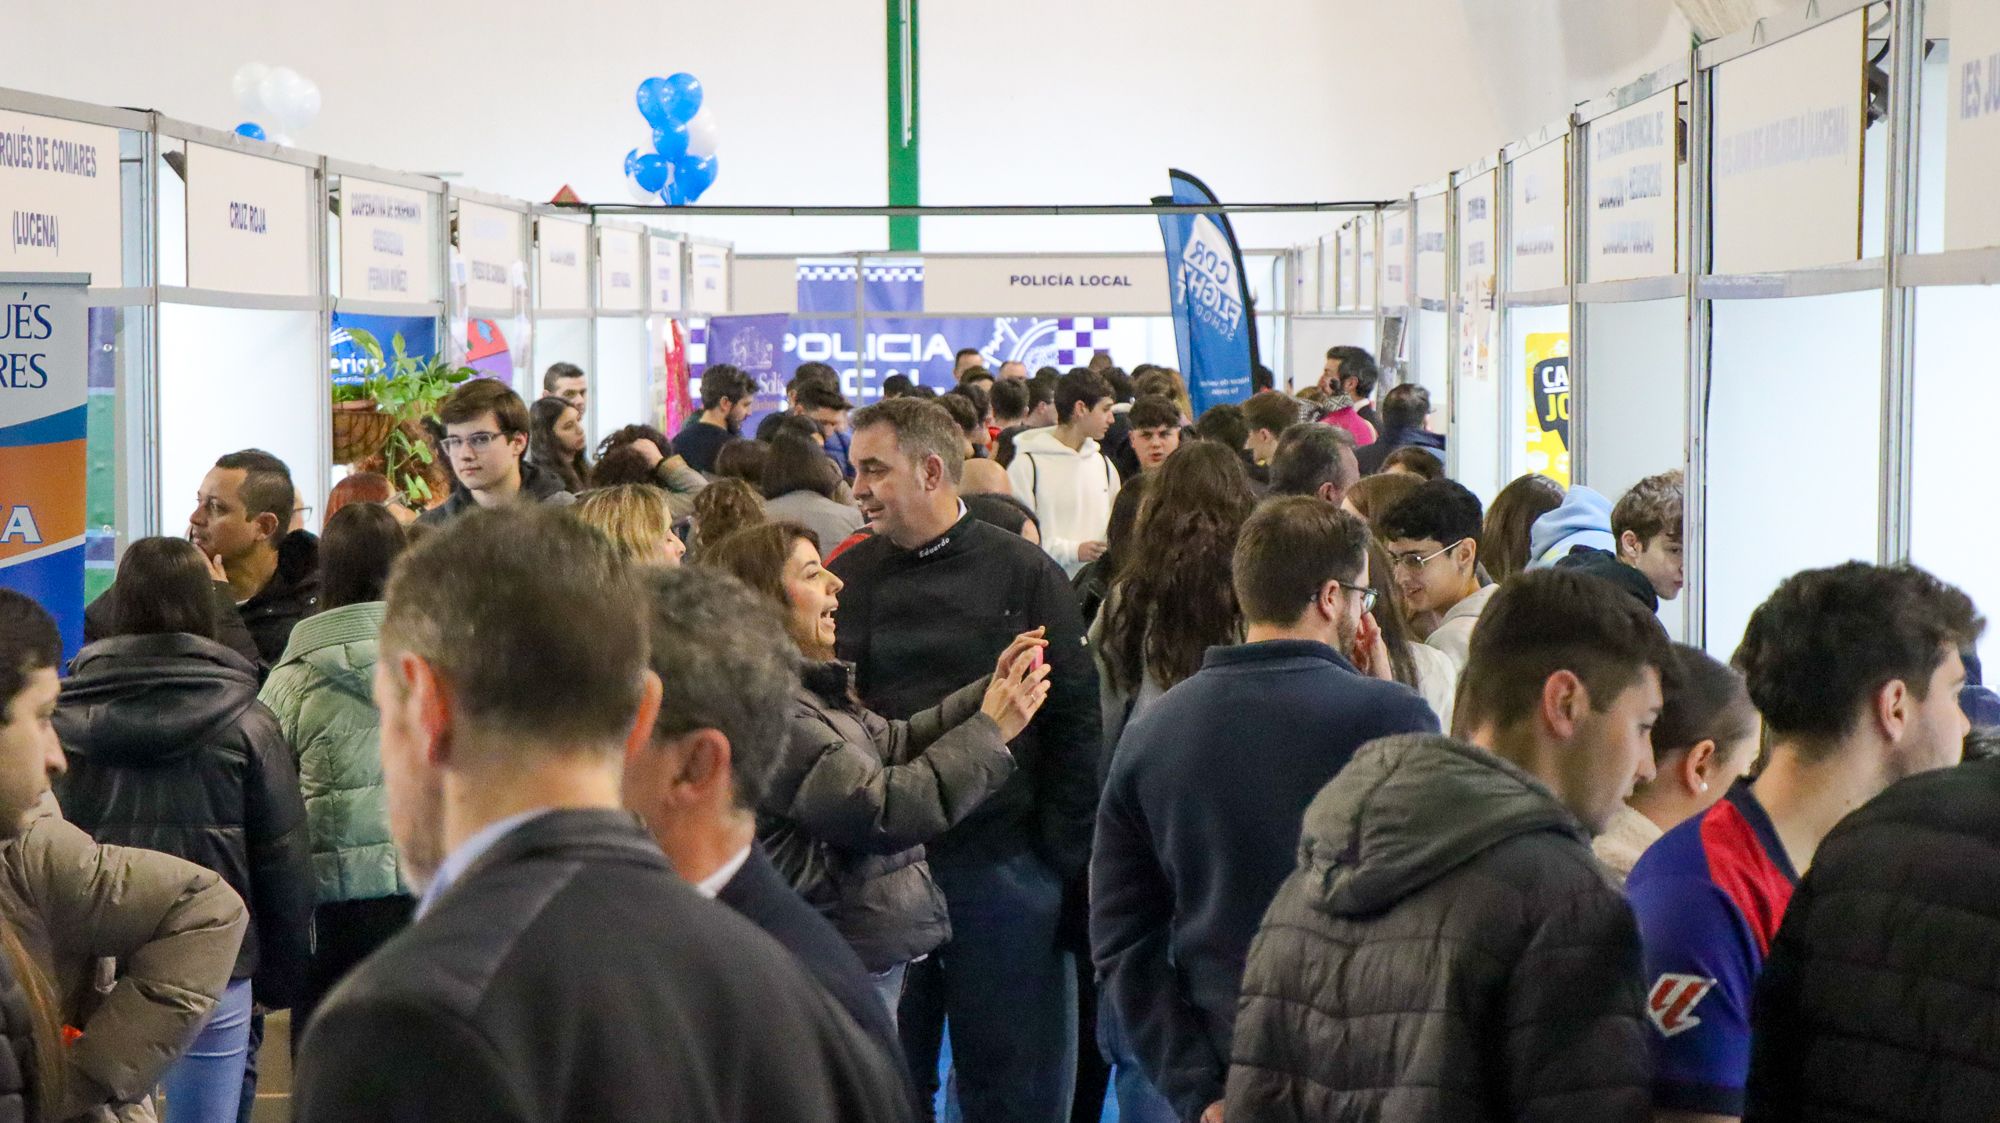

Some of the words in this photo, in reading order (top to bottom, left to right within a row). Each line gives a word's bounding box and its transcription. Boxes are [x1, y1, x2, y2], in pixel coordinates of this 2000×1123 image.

[37, 138, 50, 171] DE
[51, 141, 97, 178] COMARES
[229, 201, 248, 230] CRUZ
[250, 204, 267, 234] ROJA
[12, 209, 59, 257] (LUCENA)
[1010, 274, 1074, 286] POLICÍA
[1080, 275, 1132, 286] LOCAL
[1541, 365, 1568, 388] CA
[919, 537, 950, 558] Eduardo
